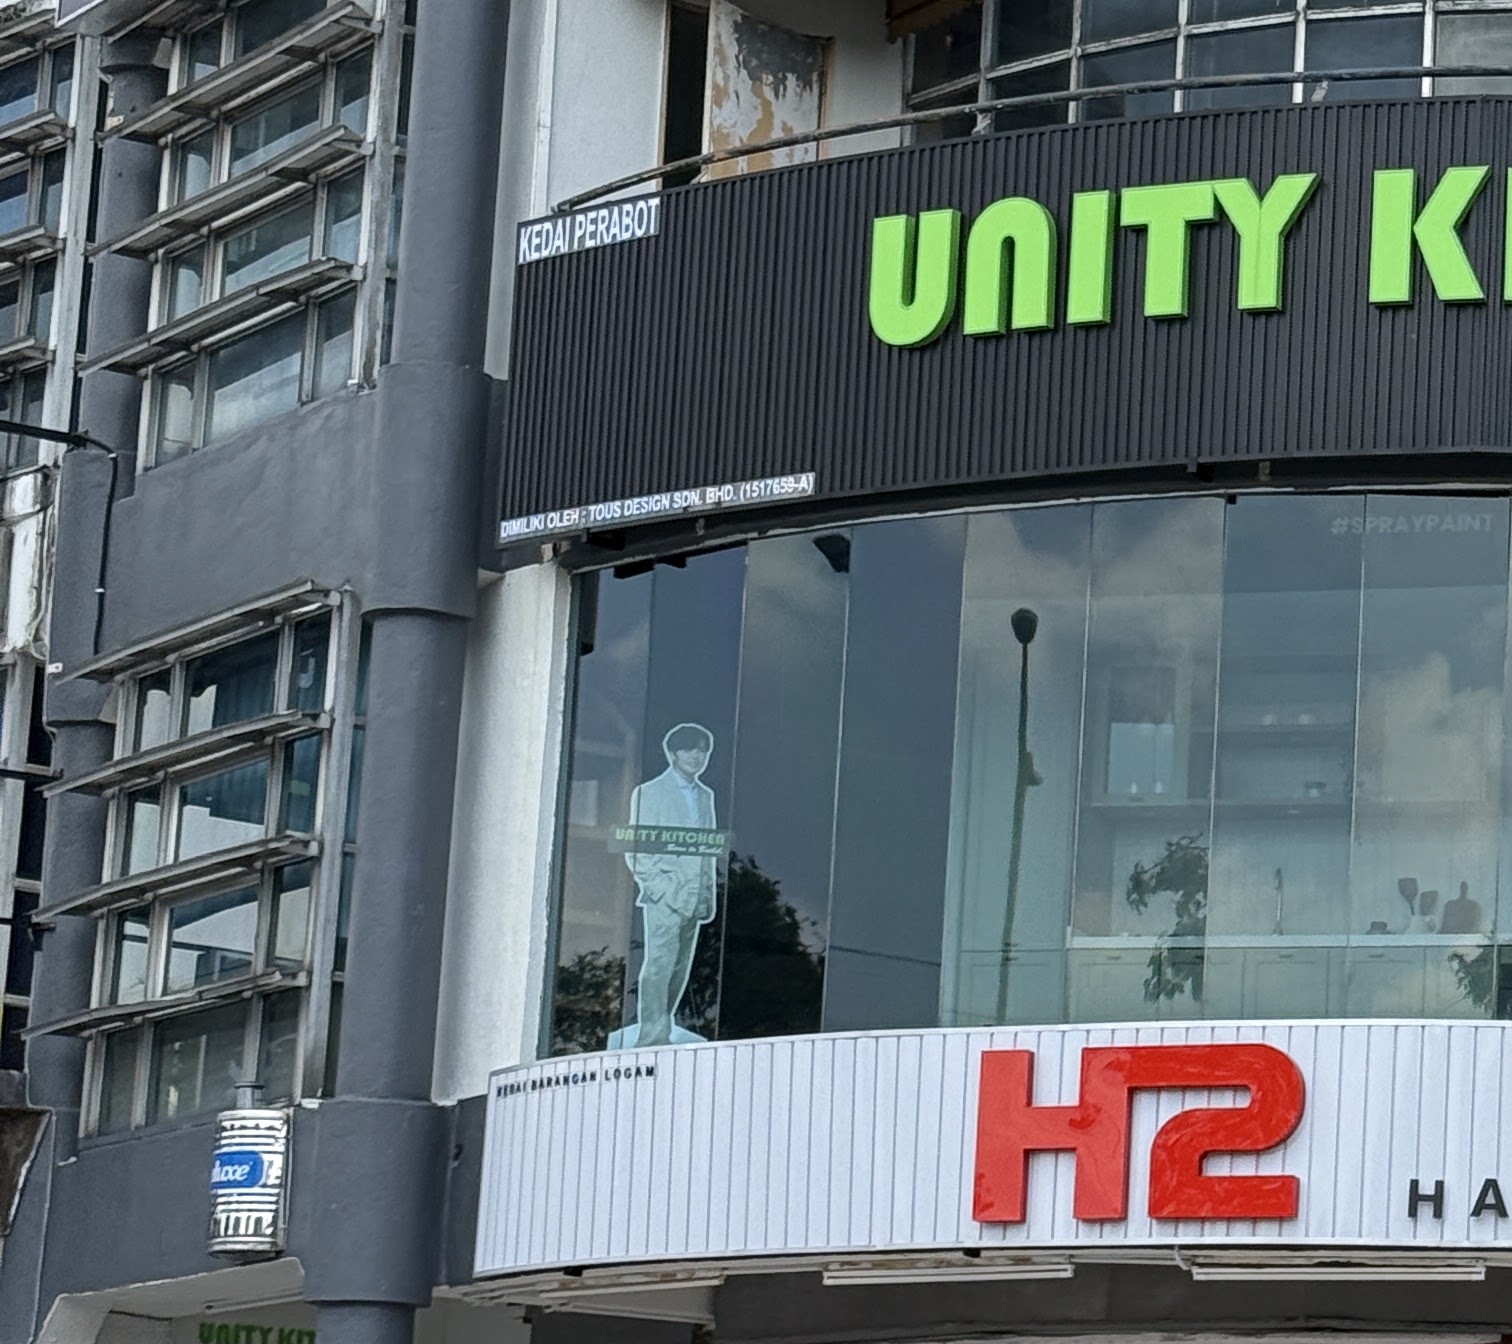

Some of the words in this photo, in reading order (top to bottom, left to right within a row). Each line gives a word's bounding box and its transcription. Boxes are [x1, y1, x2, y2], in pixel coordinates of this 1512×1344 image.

[518, 217, 570, 263] KEDAI
[573, 197, 660, 249] PERABOT
[869, 172, 1321, 348] UNITY
[501, 513, 545, 538] DIMILIKI
[547, 508, 579, 529] OLEH
[588, 501, 622, 522] TOUS
[624, 494, 671, 517] DESIGN
[672, 490, 703, 509] SDN.
[1330, 513, 1494, 536] #SPRAYPAINT
[531, 1070, 597, 1091] BARANGAN
[604, 1066, 655, 1081] LOGAM
[972, 1043, 1306, 1223] H2
